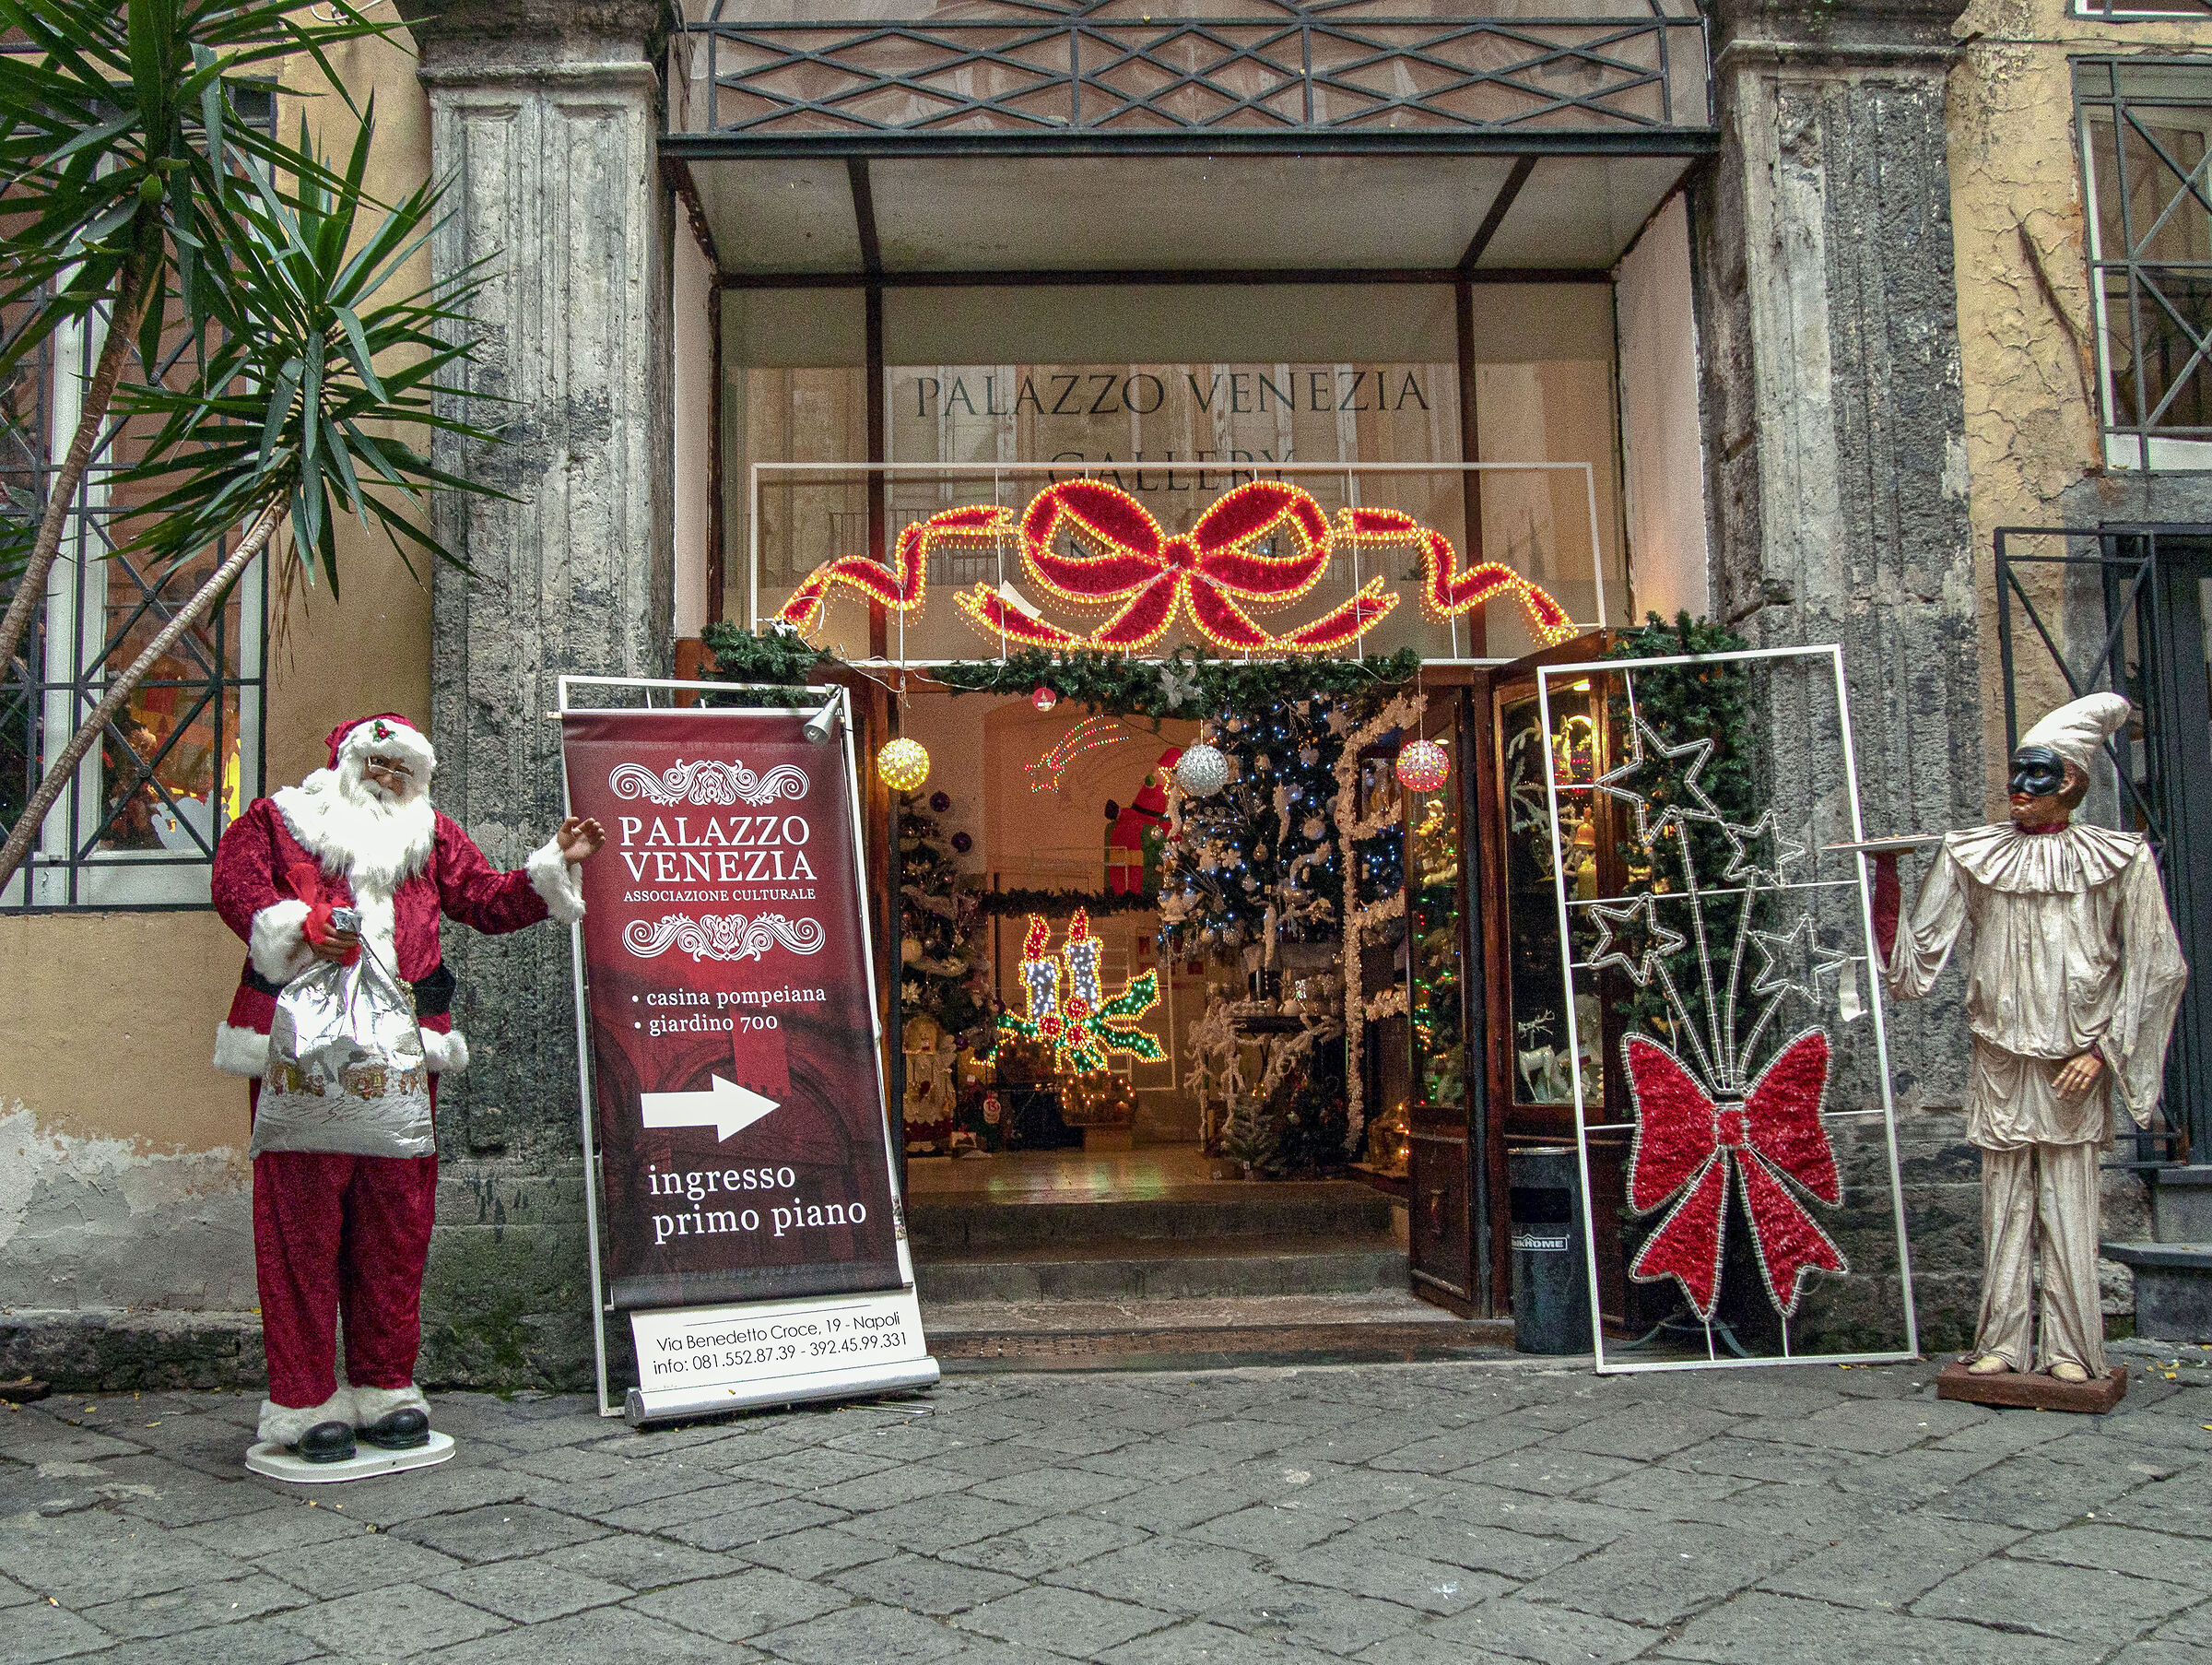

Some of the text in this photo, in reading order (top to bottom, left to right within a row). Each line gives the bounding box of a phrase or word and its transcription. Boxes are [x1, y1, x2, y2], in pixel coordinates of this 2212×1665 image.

[917, 370, 1430, 417] PALAZZO VENEZIA
[618, 815, 810, 846] PALAZZO
[619, 849, 818, 882] VENEZIA
[623, 888, 817, 903] ASSOCIAZIONE CULTURALE
[646, 986, 827, 1009] casina pompeiana
[649, 1014, 778, 1036] giardino 700
[648, 1164, 795, 1201] ingresso
[652, 1197, 866, 1246] primo piano
[656, 1336, 683, 1352] Via
[688, 1326, 767, 1349] Benedetto
[771, 1324, 822, 1340] Croce,
[826, 1318, 841, 1334] 19
[853, 1311, 900, 1331] Napoli
[653, 1355, 689, 1375] info:
[693, 1345, 795, 1370] 081.552.87.39
[810, 1331, 907, 1357] 392.45.99.331
